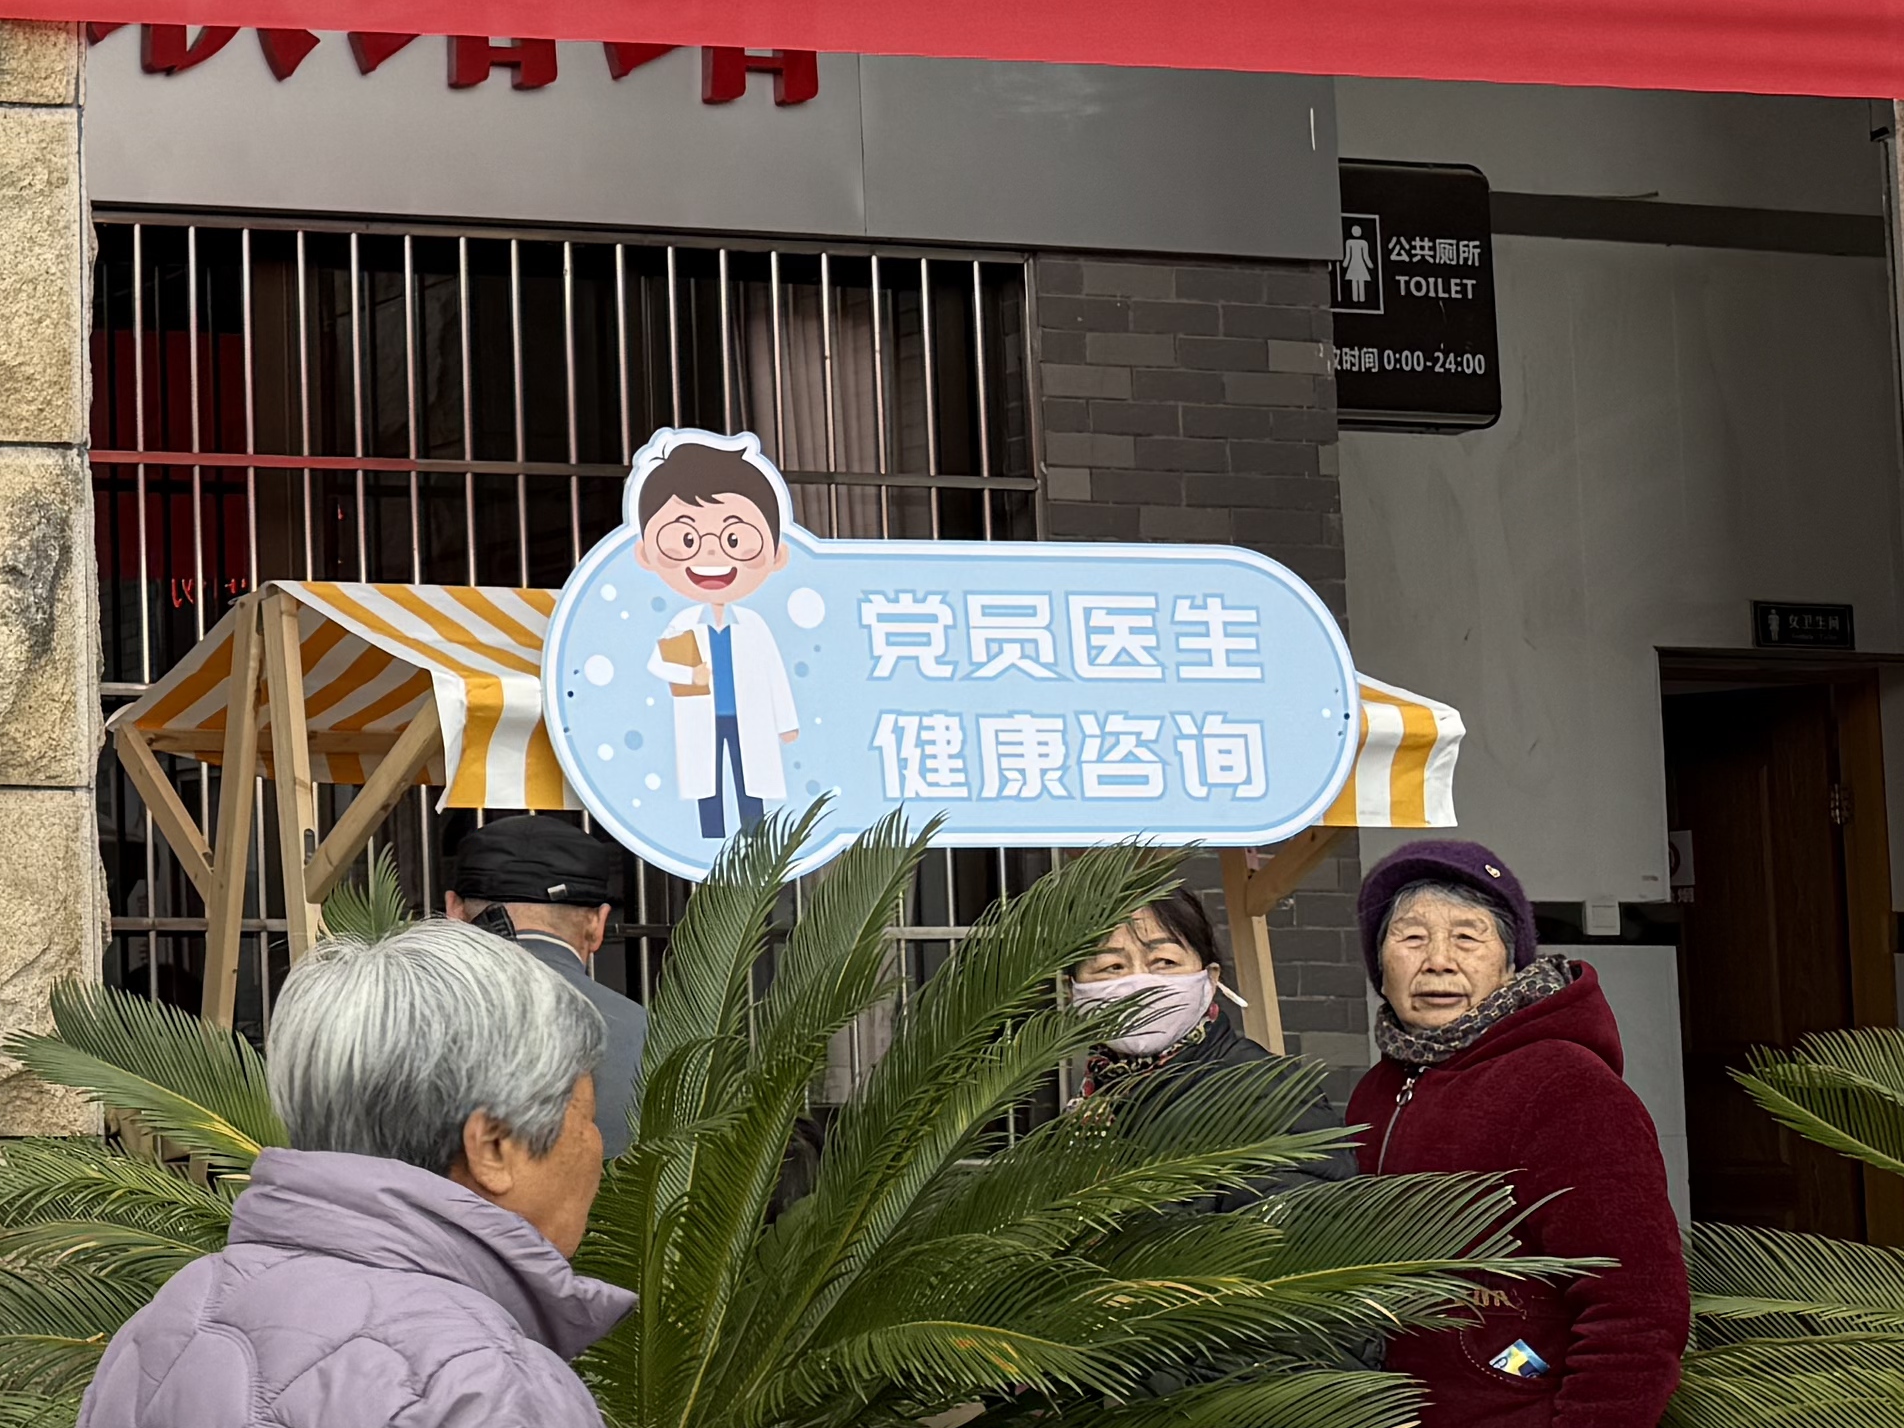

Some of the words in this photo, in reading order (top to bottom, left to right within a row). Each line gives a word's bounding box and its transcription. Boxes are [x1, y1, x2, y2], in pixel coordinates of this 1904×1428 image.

[1388, 237, 1481, 267] 公共厕所
[1395, 275, 1476, 300] TOILET
[1383, 349, 1486, 375] 0:00-24:00
[861, 591, 1264, 682] 党员医生
[872, 710, 1270, 801] 健康咨询
